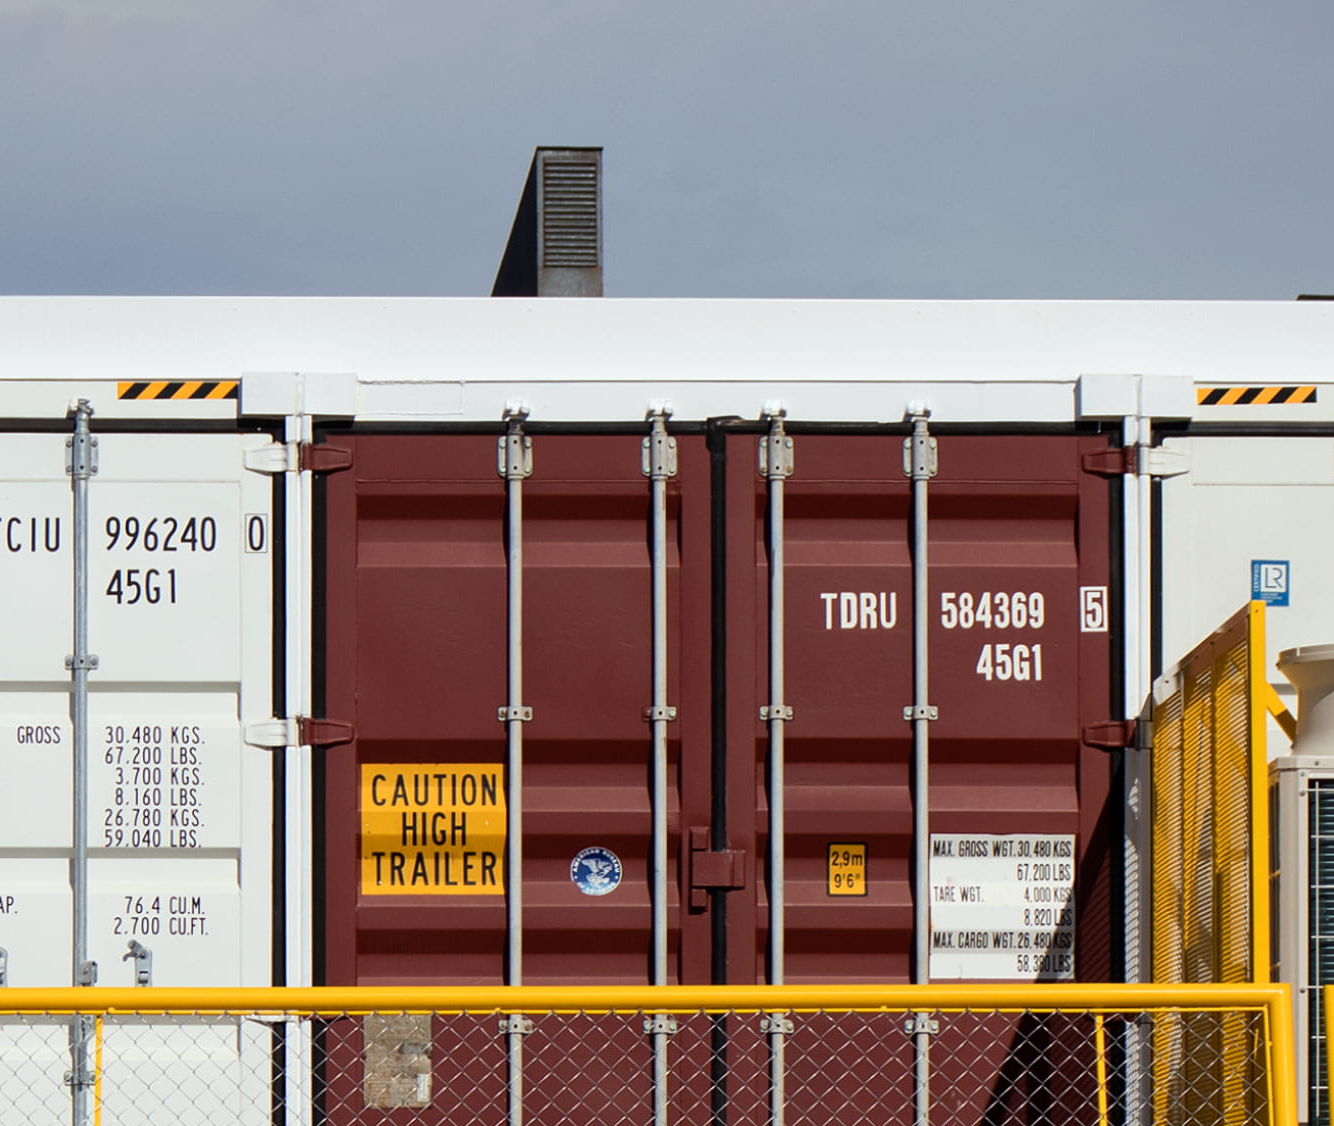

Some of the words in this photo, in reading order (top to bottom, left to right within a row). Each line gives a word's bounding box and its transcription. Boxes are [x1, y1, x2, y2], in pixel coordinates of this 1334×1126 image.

[106, 517, 216, 551] 996240
[249, 517, 264, 551] 0
[107, 569, 175, 604] 45G1
[1265, 567, 1283, 588] LR
[821, 593, 896, 629] TDRU
[942, 592, 1043, 628] 584369
[1087, 593, 1101, 627] 5
[977, 644, 1041, 680] 45G1
[18, 726, 60, 744] GROSS
[106, 726, 161, 744] 30.480
[171, 727, 204, 744] KGS.
[105, 747, 161, 764] 67.200
[171, 747, 201, 765] LBS.
[116, 767, 161, 785] 3.700
[171, 768, 204, 785] KGS.
[115, 788, 161, 806] 8.160
[171, 788, 201, 806] LBS.
[372, 774, 496, 806] CAUTION
[105, 809, 161, 826] 26.780
[171, 809, 204, 827] KGS.
[105, 829, 161, 847] 59.040
[170, 829, 201, 847] LBS.
[402, 812, 466, 846] HIGH
[933, 840, 955, 857] MAX.
[959, 840, 988, 857] GROSS
[993, 840, 1016, 857] WGT.
[1018, 840, 1050, 857] 30,480
[1053, 840, 1071, 857] KGS
[371, 851, 496, 886] TRAILER
[832, 851, 863, 868] 2,9m
[1017, 864, 1050, 881] 67,200
[1053, 864, 1071, 881] LBS
[934, 887, 955, 902] TARE
[960, 887, 984, 902] WGT.
[1024, 887, 1051, 902] 4,000
[1054, 887, 1072, 903] KGS
[125, 896, 160, 914] 76.4
[170, 897, 204, 914] CU.M.
[114, 917, 159, 935] 2.700
[170, 917, 207, 935] CU.FT.
[1024, 909, 1051, 926] 8,820
[1054, 909, 1072, 926] LBS
[933, 932, 955, 948] MAX.
[958, 932, 988, 948] CARGO
[993, 932, 1016, 948] WGT.
[1018, 932, 1050, 949] 26,480
[1053, 933, 1072, 949] KGS
[1017, 955, 1050, 972] 58,380
[1053, 955, 1071, 972] LBS
